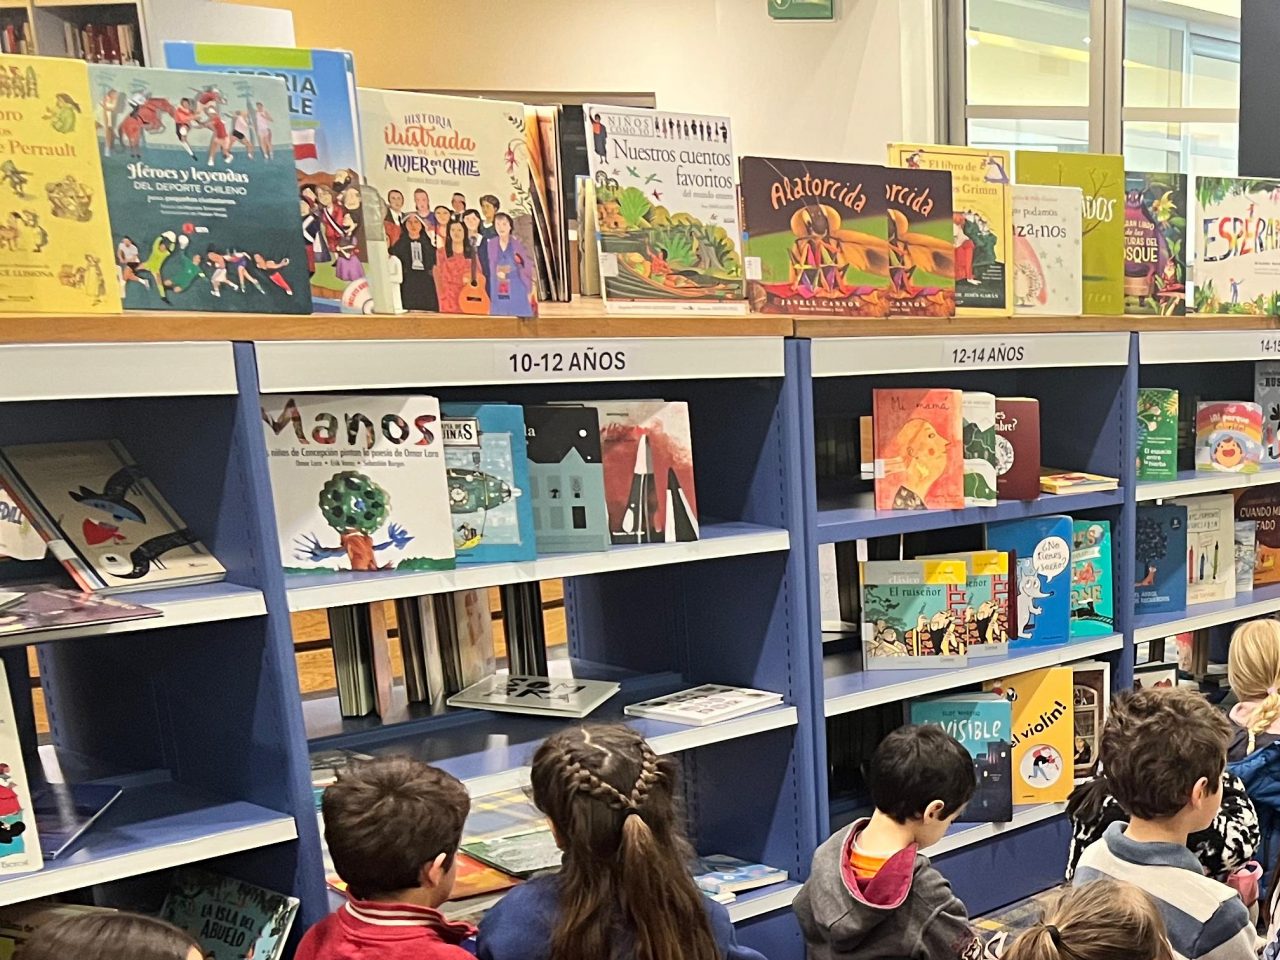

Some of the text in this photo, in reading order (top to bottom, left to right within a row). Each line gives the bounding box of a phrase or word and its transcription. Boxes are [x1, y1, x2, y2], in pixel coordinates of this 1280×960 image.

[404, 112, 453, 129] HISTORIA
[607, 115, 651, 128] NIÑOS
[384, 121, 477, 152] ilustrada
[9, 140, 77, 157] Perrault
[613, 138, 731, 167] Nuestros cuentos
[126, 161, 249, 185] Héroes y leyendas
[384, 153, 437, 176] MUJER
[442, 157, 481, 177] CHILE
[928, 159, 977, 171] El libro de
[676, 164, 733, 189] favoritos
[133, 180, 248, 196] DEL DEPORTE CHILENO
[771, 171, 867, 214] Alatorcida
[962, 184, 998, 195] Grimm
[885, 183, 934, 218] rcida
[1023, 202, 1058, 220] podamos
[1146, 237, 1158, 247] DEL
[1124, 246, 1158, 263] SQUE
[780, 299, 818, 307] JANELL
[509, 347, 626, 372] 10-12 AÑOS
[952, 342, 1025, 363] 12-14 AÑOS
[916, 396, 949, 411] mamá
[261, 397, 437, 450] Manos
[1240, 506, 1272, 518] CUANDO
[889, 586, 942, 597] El ruiseñor
[1021, 700, 1067, 740] violín!
[200, 903, 256, 932] LA ISLA DEL
[201, 919, 246, 948] ABUELO
